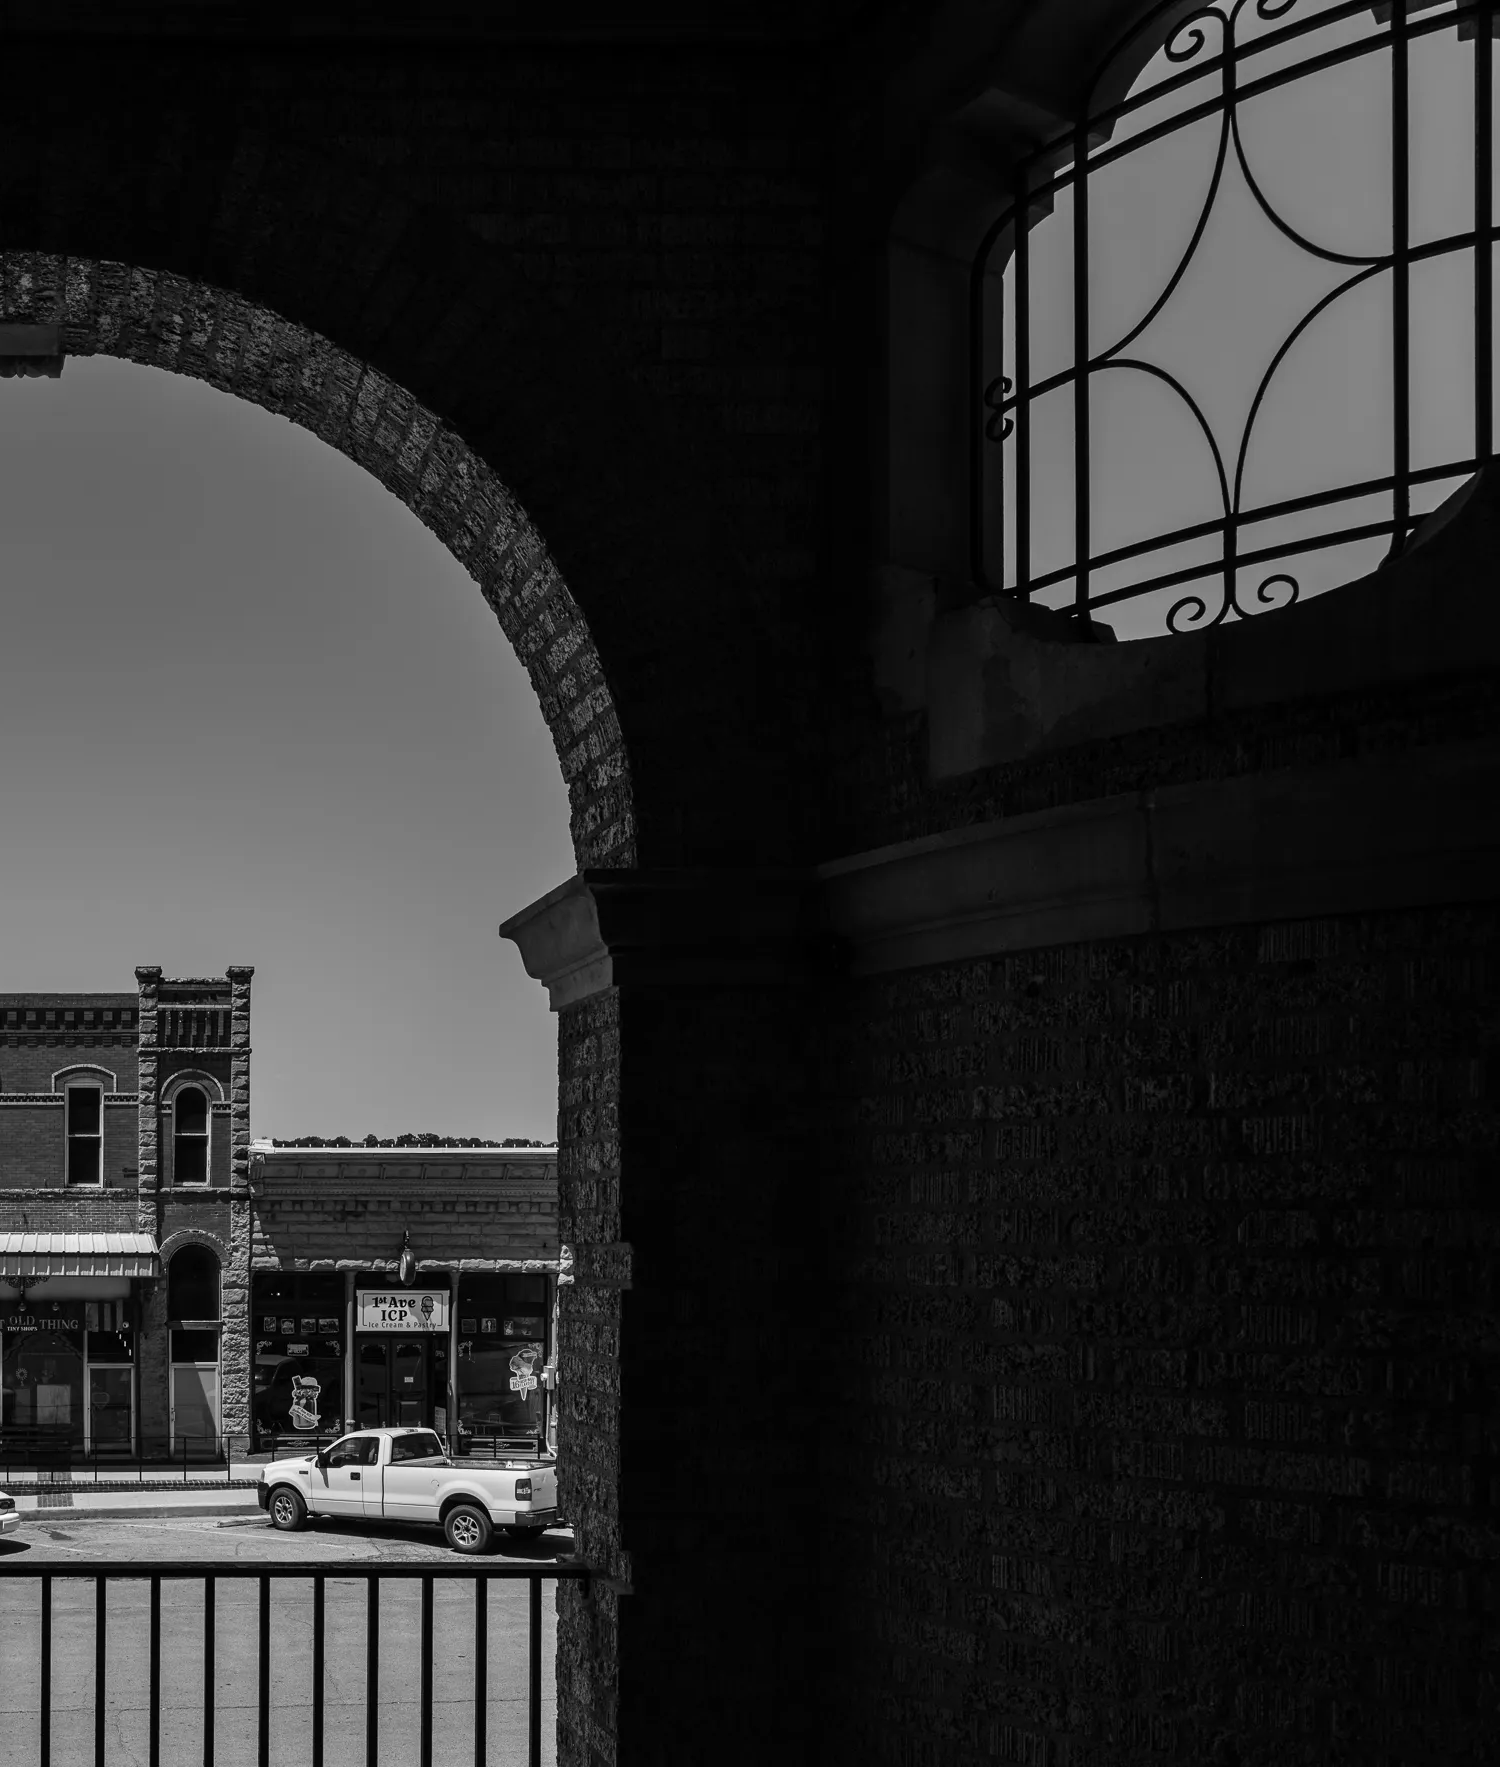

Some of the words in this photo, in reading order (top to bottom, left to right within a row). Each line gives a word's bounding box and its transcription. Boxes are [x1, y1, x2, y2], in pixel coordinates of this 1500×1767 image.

[372, 1296, 388, 1308] 1st
[388, 1296, 416, 1308] Ave
[381, 1310, 407, 1321] ICP
[9, 1315, 35, 1326] OLD
[39, 1319, 79, 1330] THING
